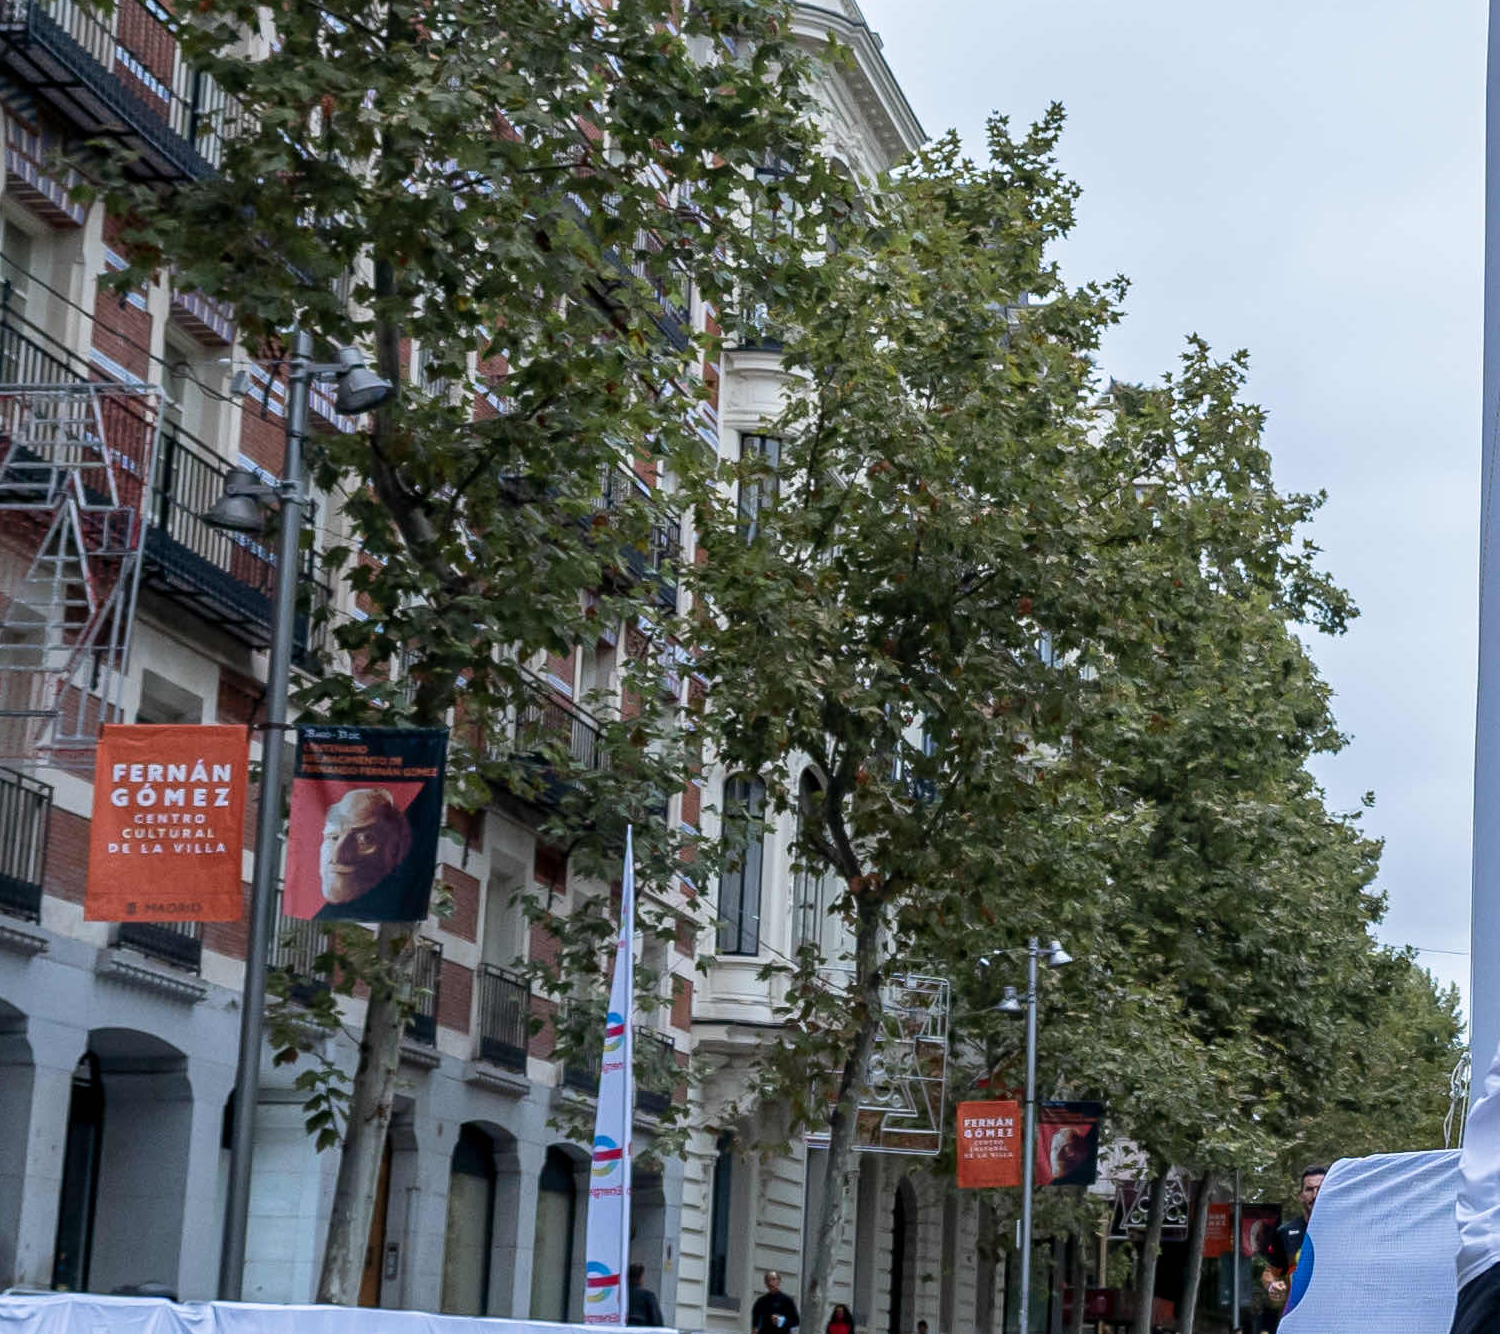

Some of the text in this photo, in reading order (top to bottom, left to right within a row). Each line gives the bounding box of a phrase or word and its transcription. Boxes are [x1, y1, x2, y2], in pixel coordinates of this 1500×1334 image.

[112, 759, 232, 783] FERNÁN
[110, 783, 231, 807] GÓMEZ
[134, 814, 206, 824] CENTRO
[122, 828, 215, 839] CULTURAL
[108, 842, 227, 854] DE LA VILLA
